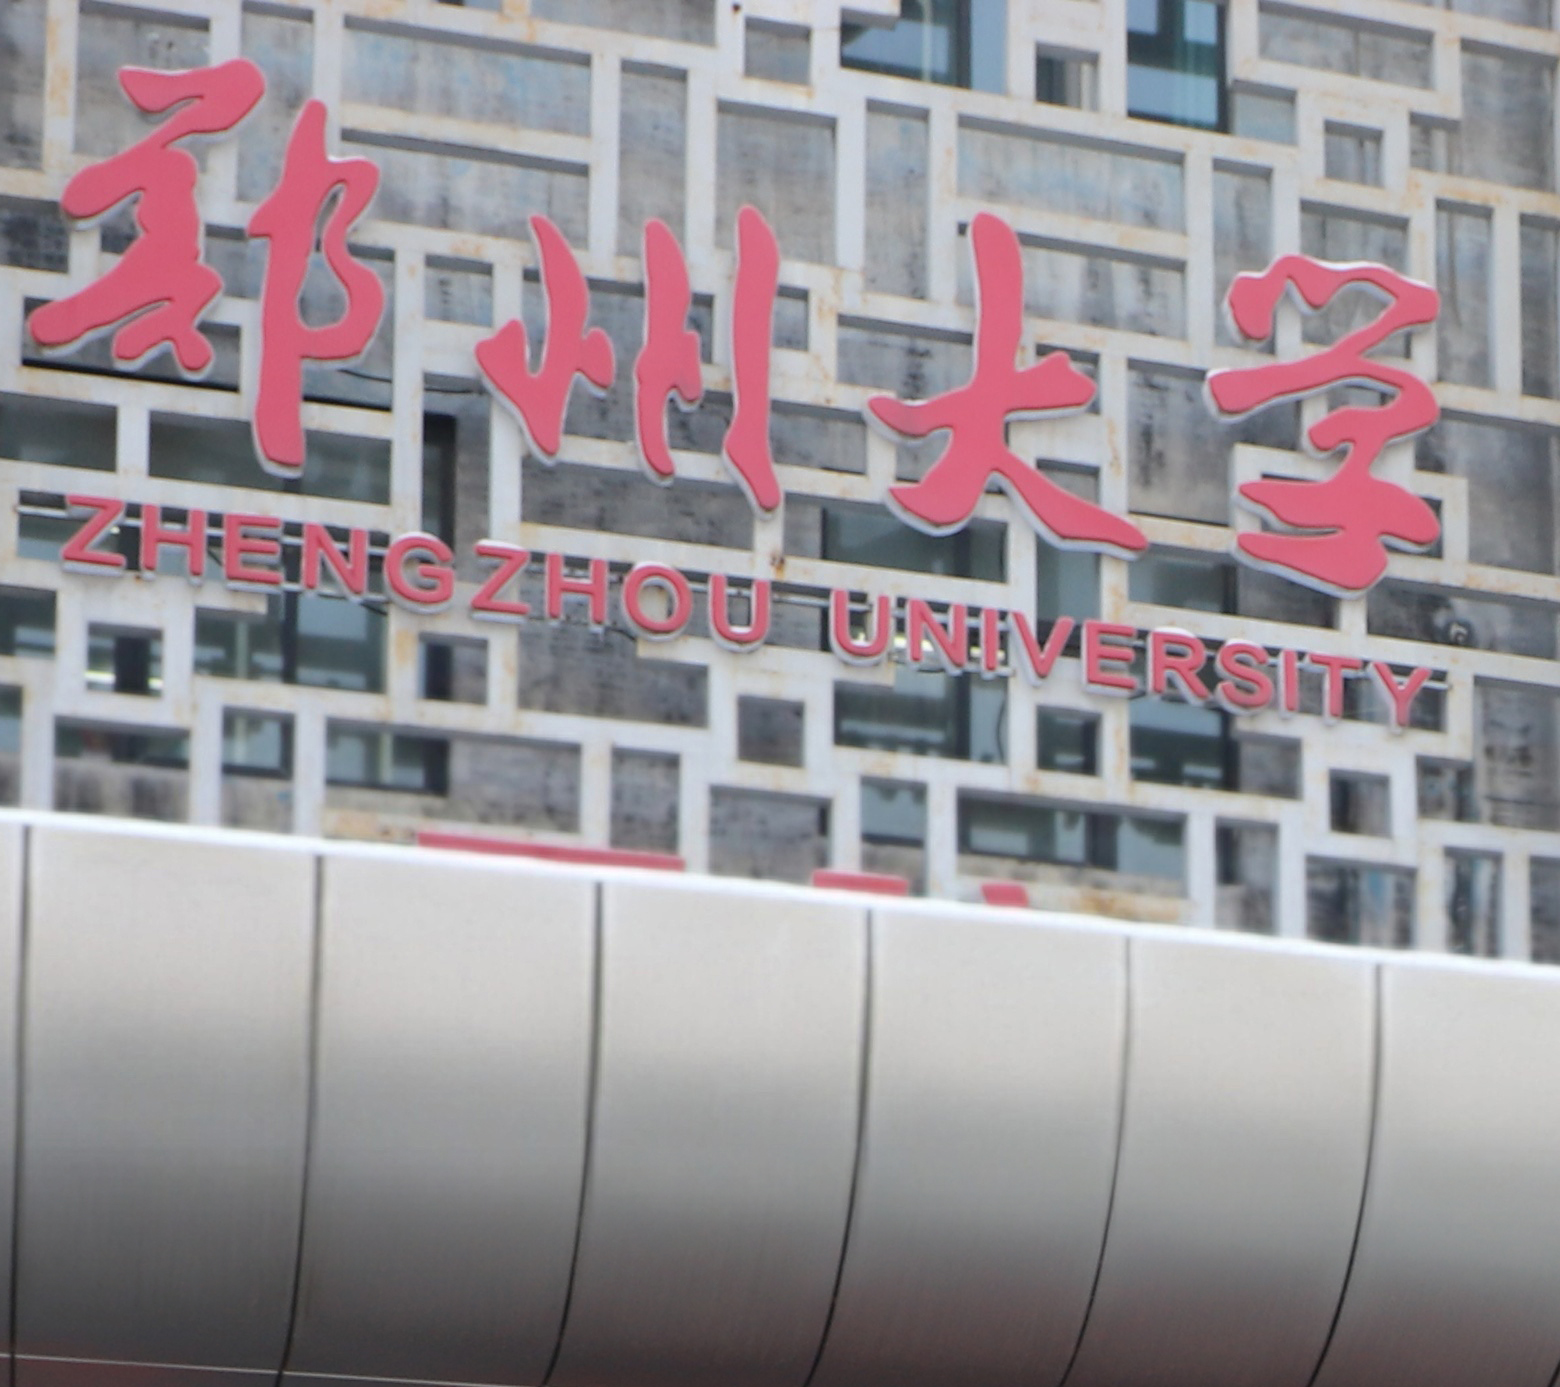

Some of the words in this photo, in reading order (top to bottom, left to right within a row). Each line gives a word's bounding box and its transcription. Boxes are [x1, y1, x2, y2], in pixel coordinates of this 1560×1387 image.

[27, 58, 1440, 596] 郑州大学
[60, 494, 772, 652] ZHENGZHOU
[828, 587, 1434, 732] UNIVERSITY
